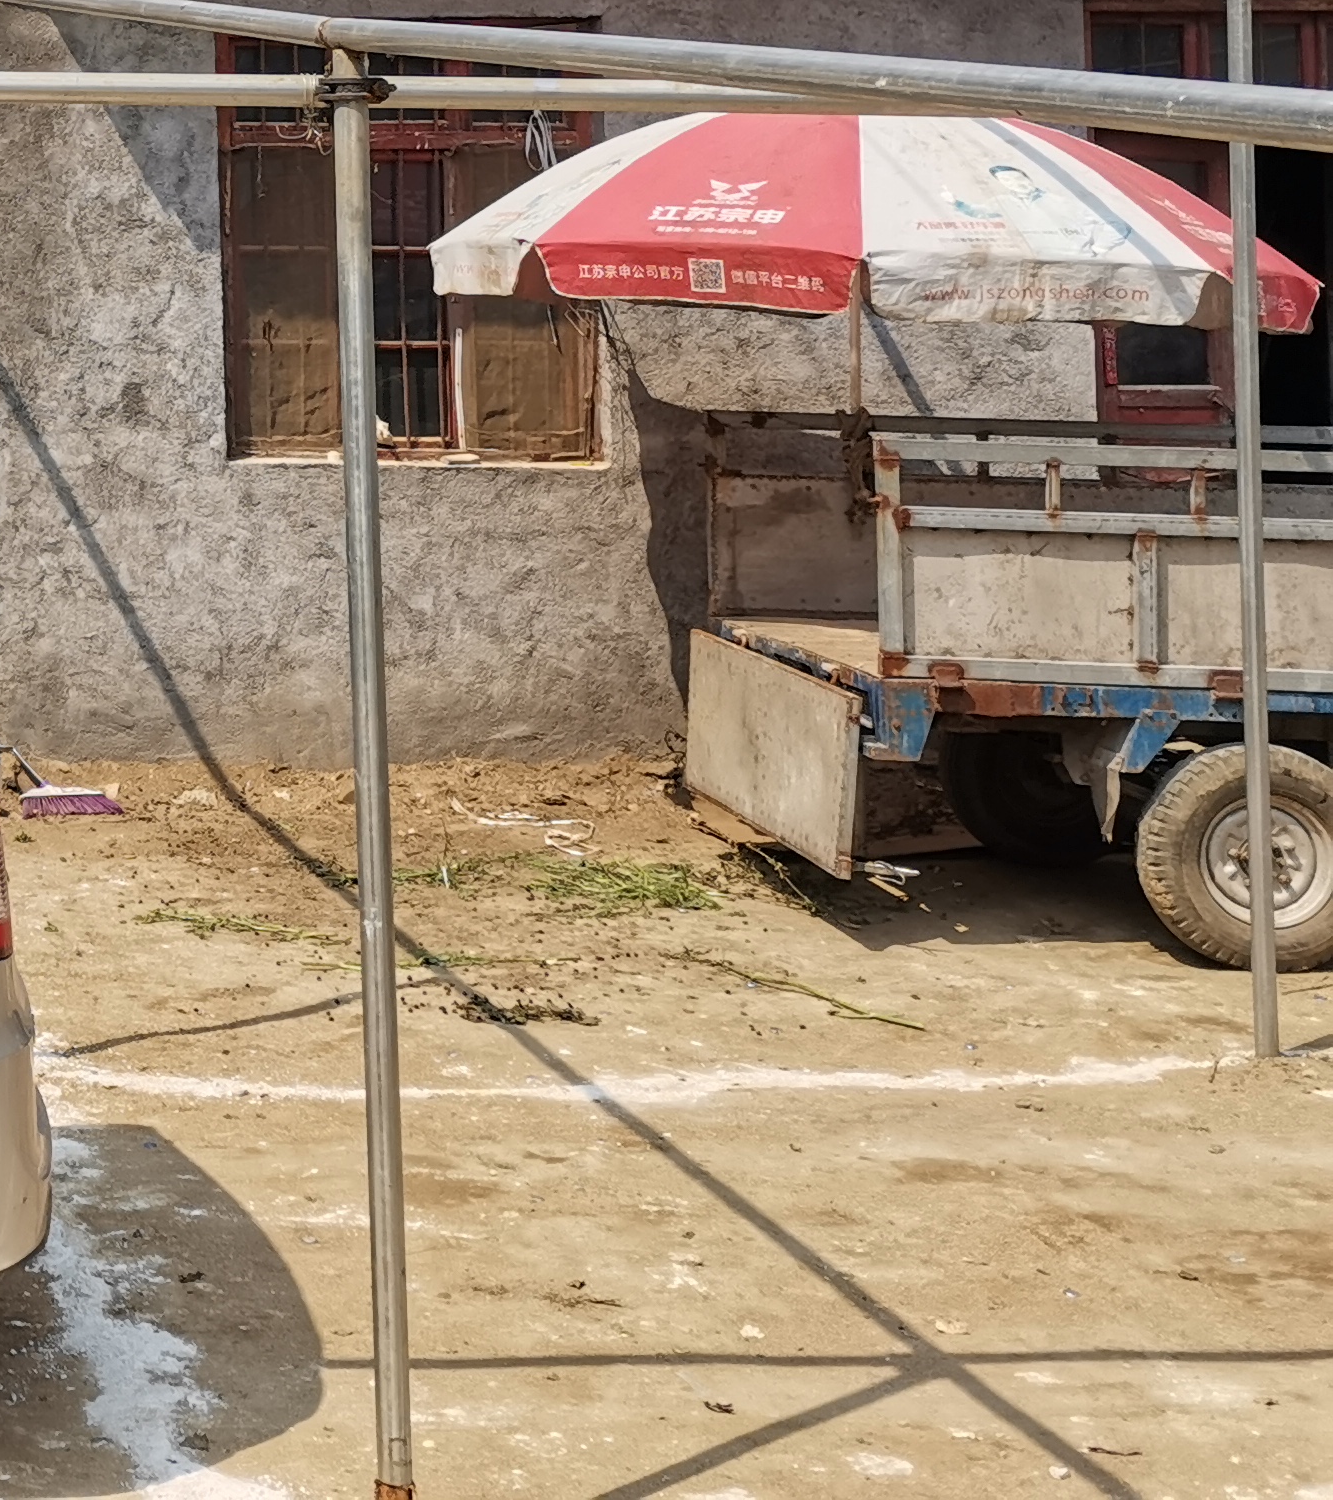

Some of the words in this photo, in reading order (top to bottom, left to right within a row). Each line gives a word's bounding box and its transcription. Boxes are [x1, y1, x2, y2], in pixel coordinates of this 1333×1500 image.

[647, 205, 787, 224] 江苏宗申
[577, 263, 685, 280] 江苏宗申公司官方
[730, 269, 825, 292] 微信平台二维码
